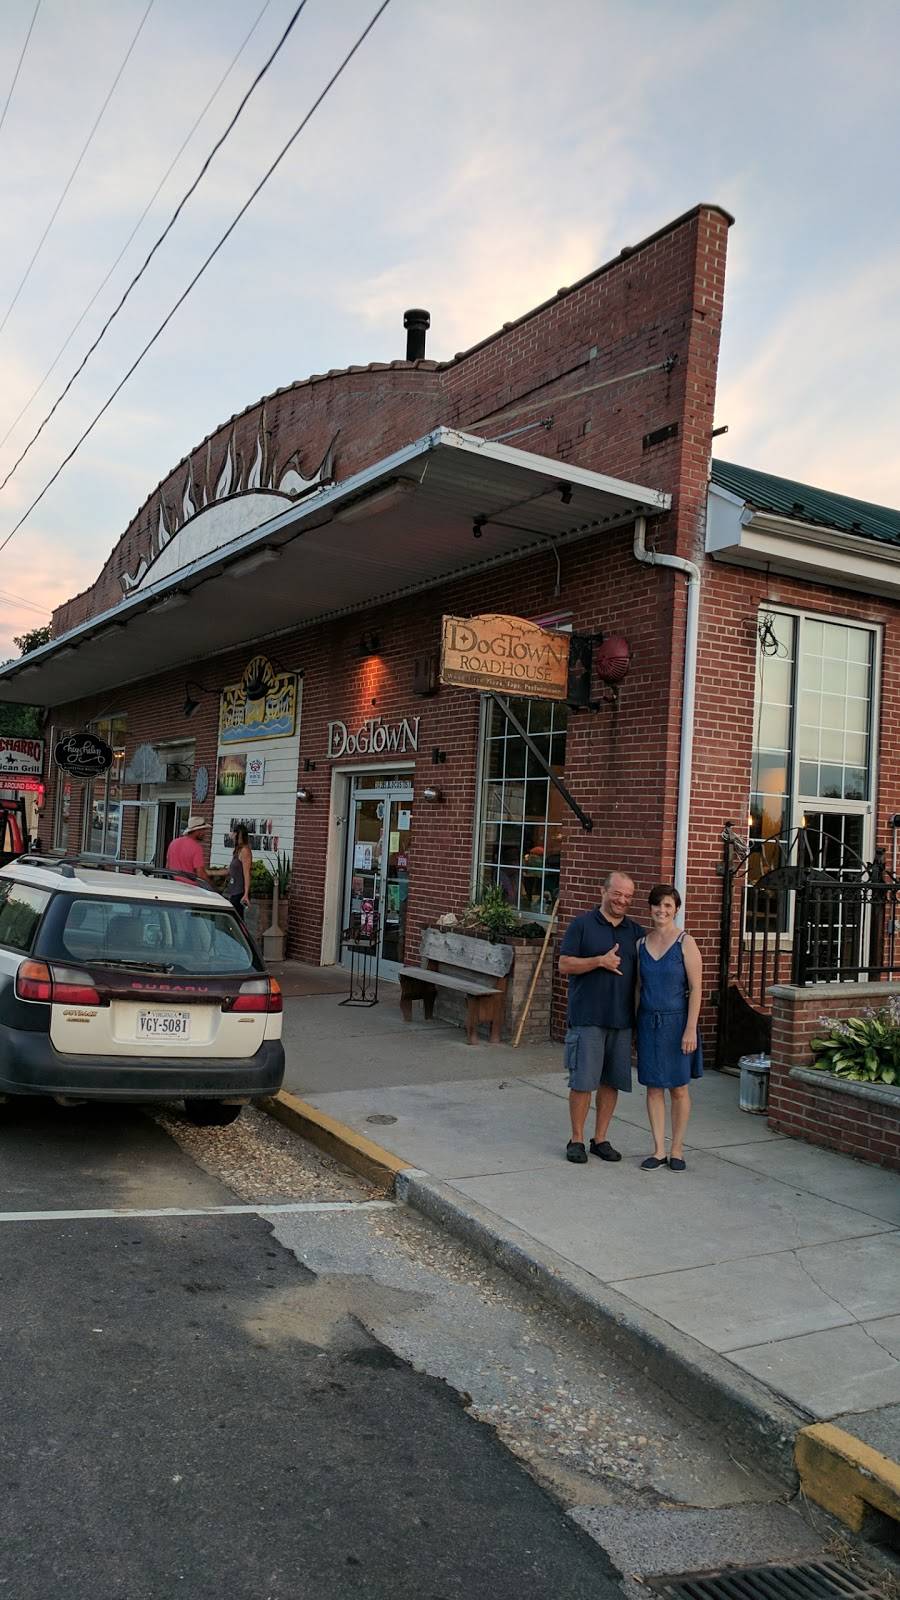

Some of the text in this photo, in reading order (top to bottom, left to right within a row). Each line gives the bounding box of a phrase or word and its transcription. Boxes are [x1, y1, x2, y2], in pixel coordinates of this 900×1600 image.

[460, 655, 552, 681] ROADHOUSE
[22, 765, 40, 773] Grill
[4, 782, 25, 790] AROUND
[131, 982, 208, 993] SUBARU
[140, 1017, 187, 1033] VGY-5081
